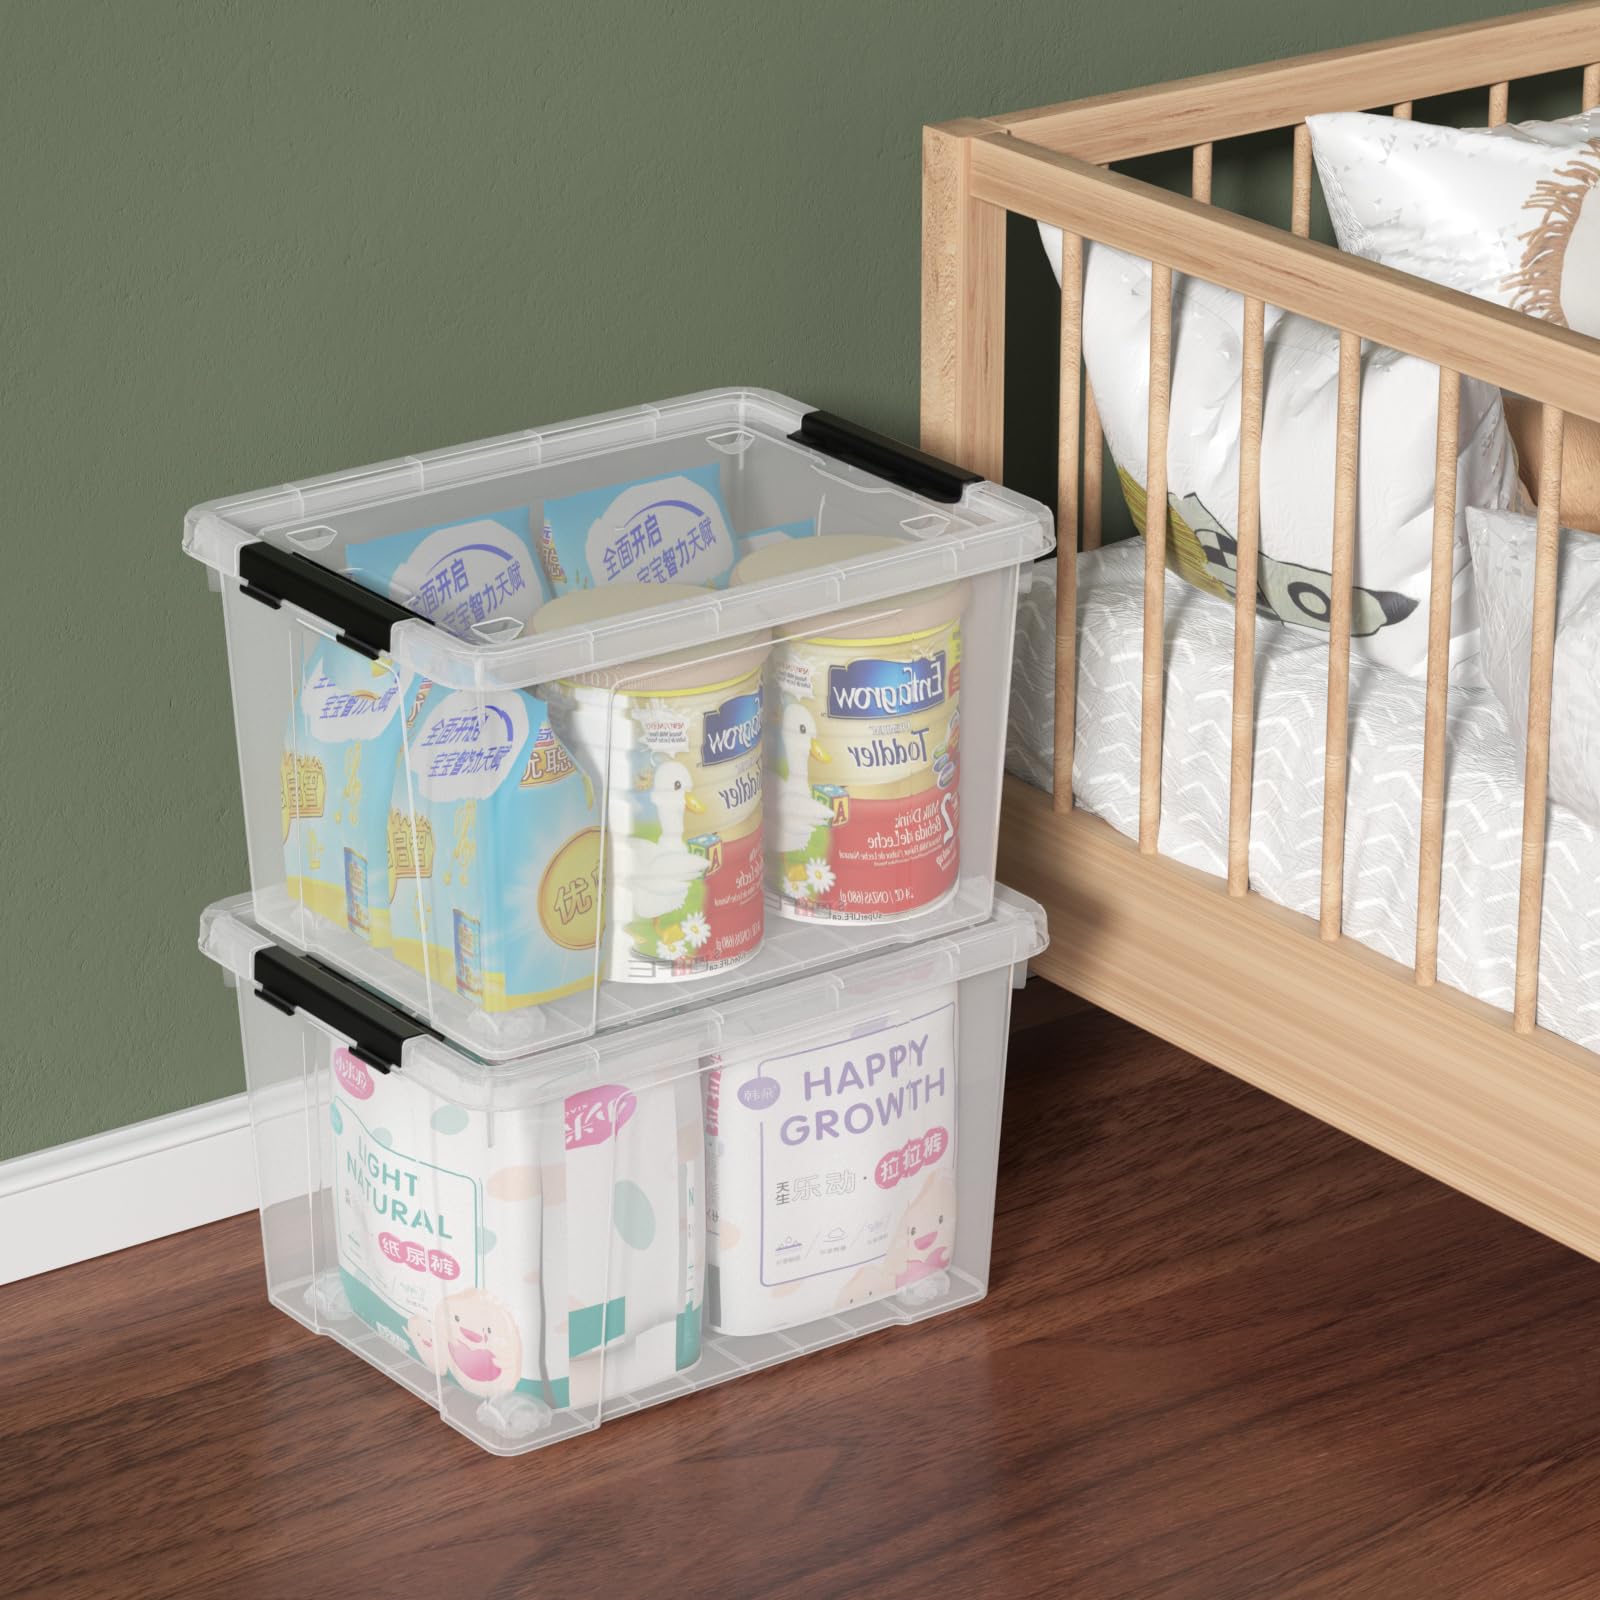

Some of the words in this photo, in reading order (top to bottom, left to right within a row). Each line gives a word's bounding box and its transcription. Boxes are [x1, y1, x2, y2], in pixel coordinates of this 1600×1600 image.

[602, 512, 664, 582] 全面开启
[804, 1034, 929, 1102] HAPPY
[780, 1067, 945, 1146] GROWTH
[358, 1135, 418, 1197] LIGHT
[880, 1131, 943, 1183] 拉拉裤
[347, 1151, 453, 1239] NATURAL
[381, 1236, 455, 1278] 纸尿裤
